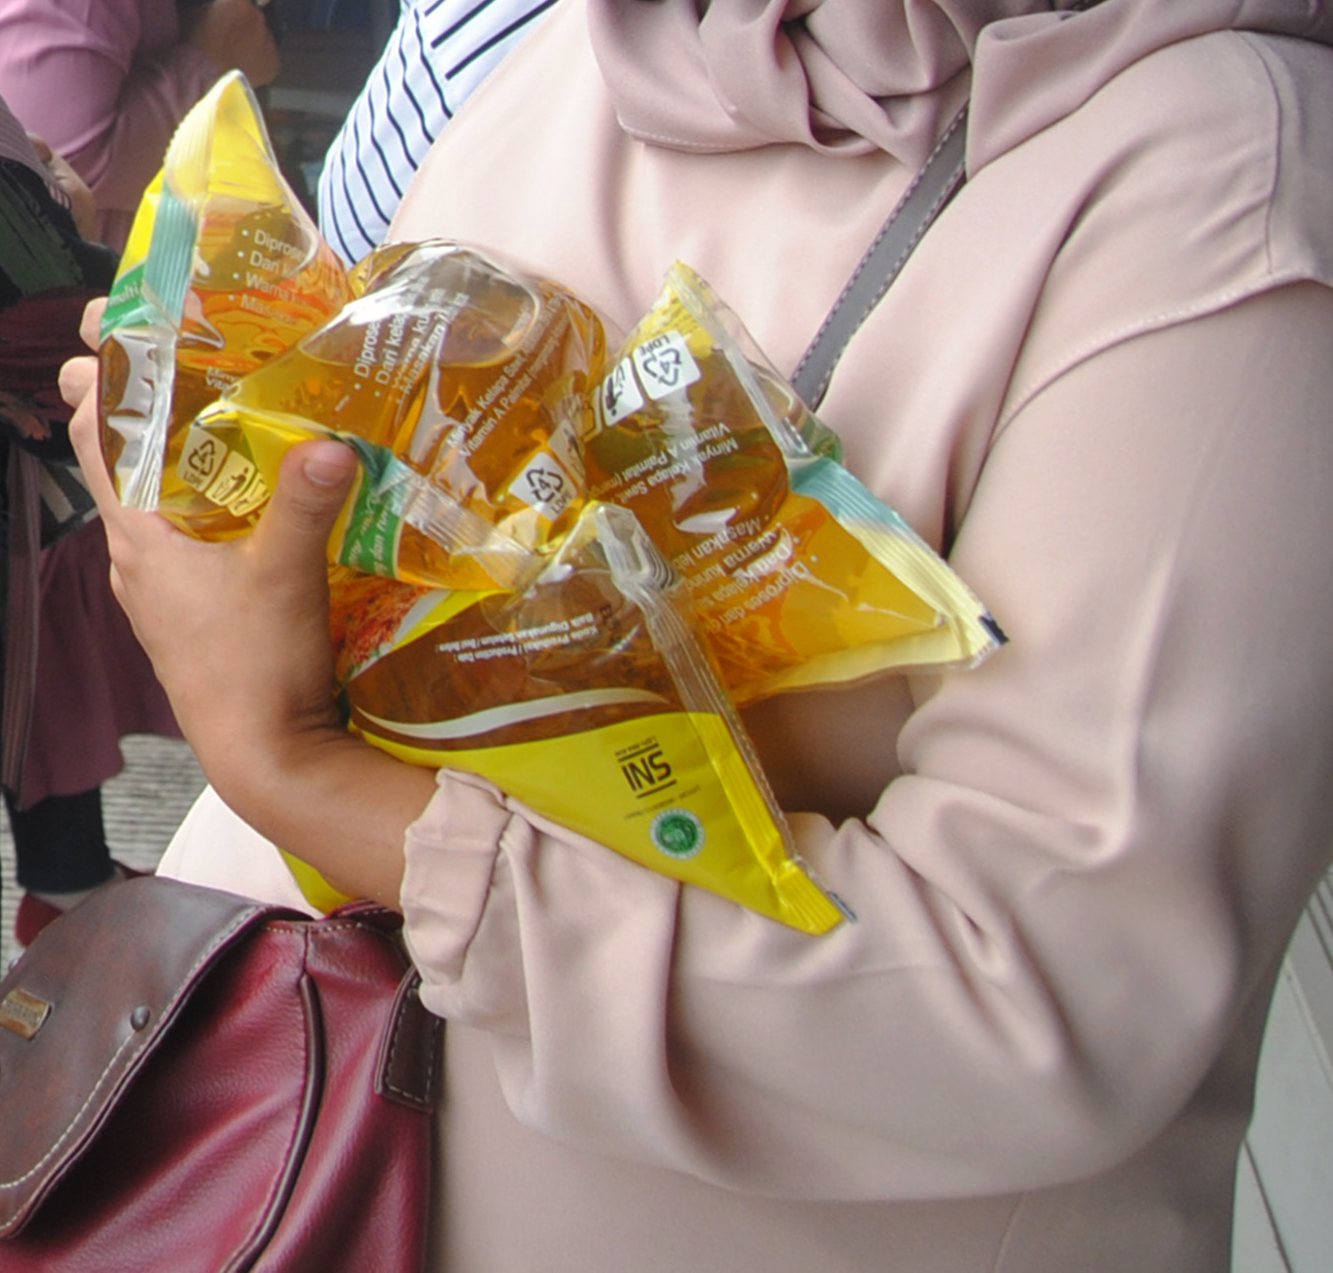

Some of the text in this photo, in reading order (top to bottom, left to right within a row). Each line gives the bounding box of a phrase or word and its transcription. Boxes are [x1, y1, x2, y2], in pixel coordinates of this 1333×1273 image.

[254, 228, 307, 262] Diprose
[354, 318, 383, 378] Diprose
[638, 334, 671, 358] LDPE
[376, 348, 398, 386] Dari
[459, 415, 498, 459] Vitamin
[550, 492, 573, 516] LDPE
[620, 749, 673, 792] SNI
